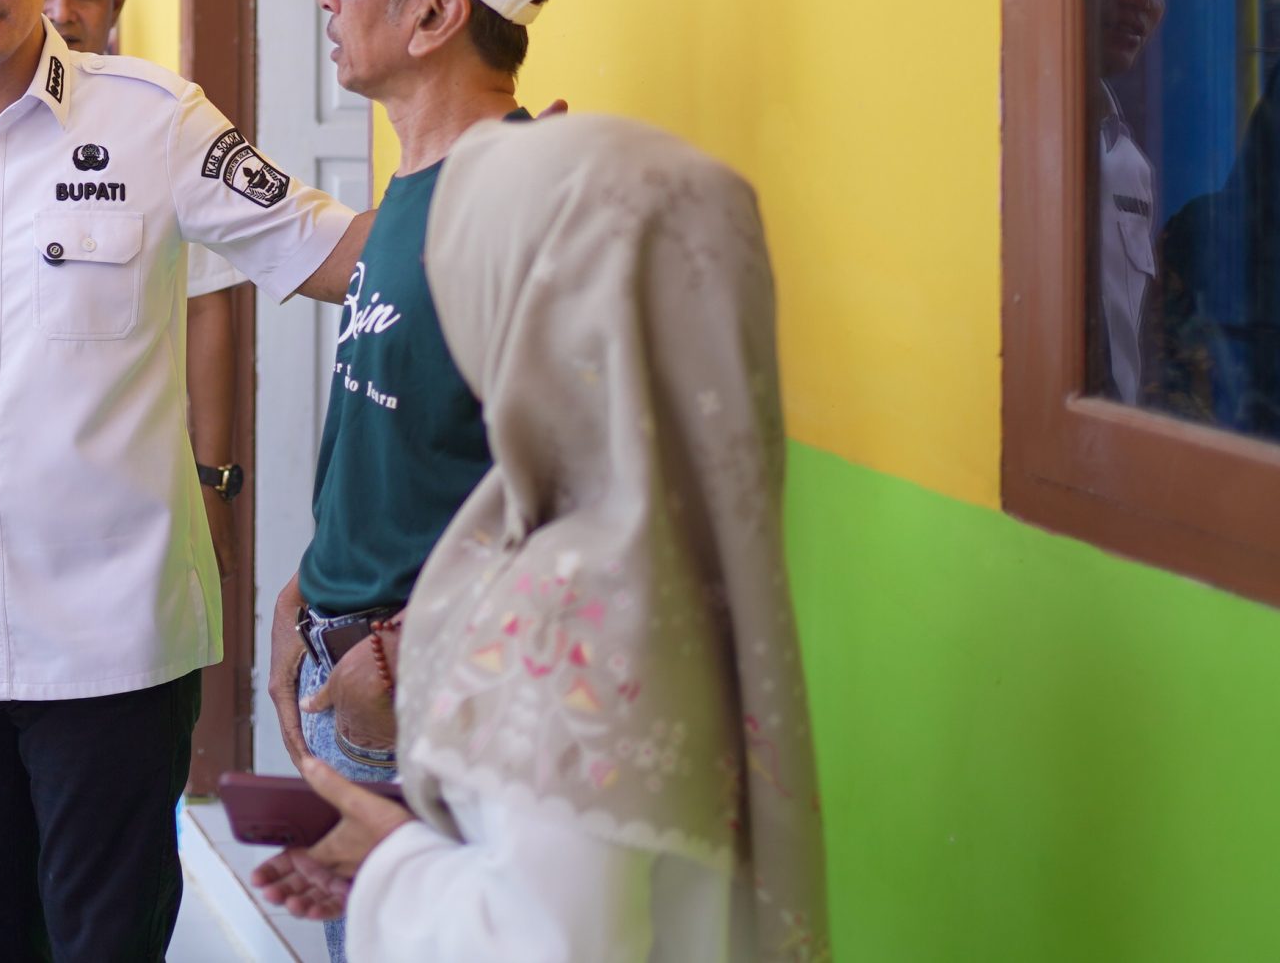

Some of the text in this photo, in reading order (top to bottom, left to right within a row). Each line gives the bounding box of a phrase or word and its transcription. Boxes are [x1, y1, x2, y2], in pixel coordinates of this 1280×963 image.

[205, 132, 240, 176] KAB. SOLOK
[56, 182, 125, 201] BUPATI
